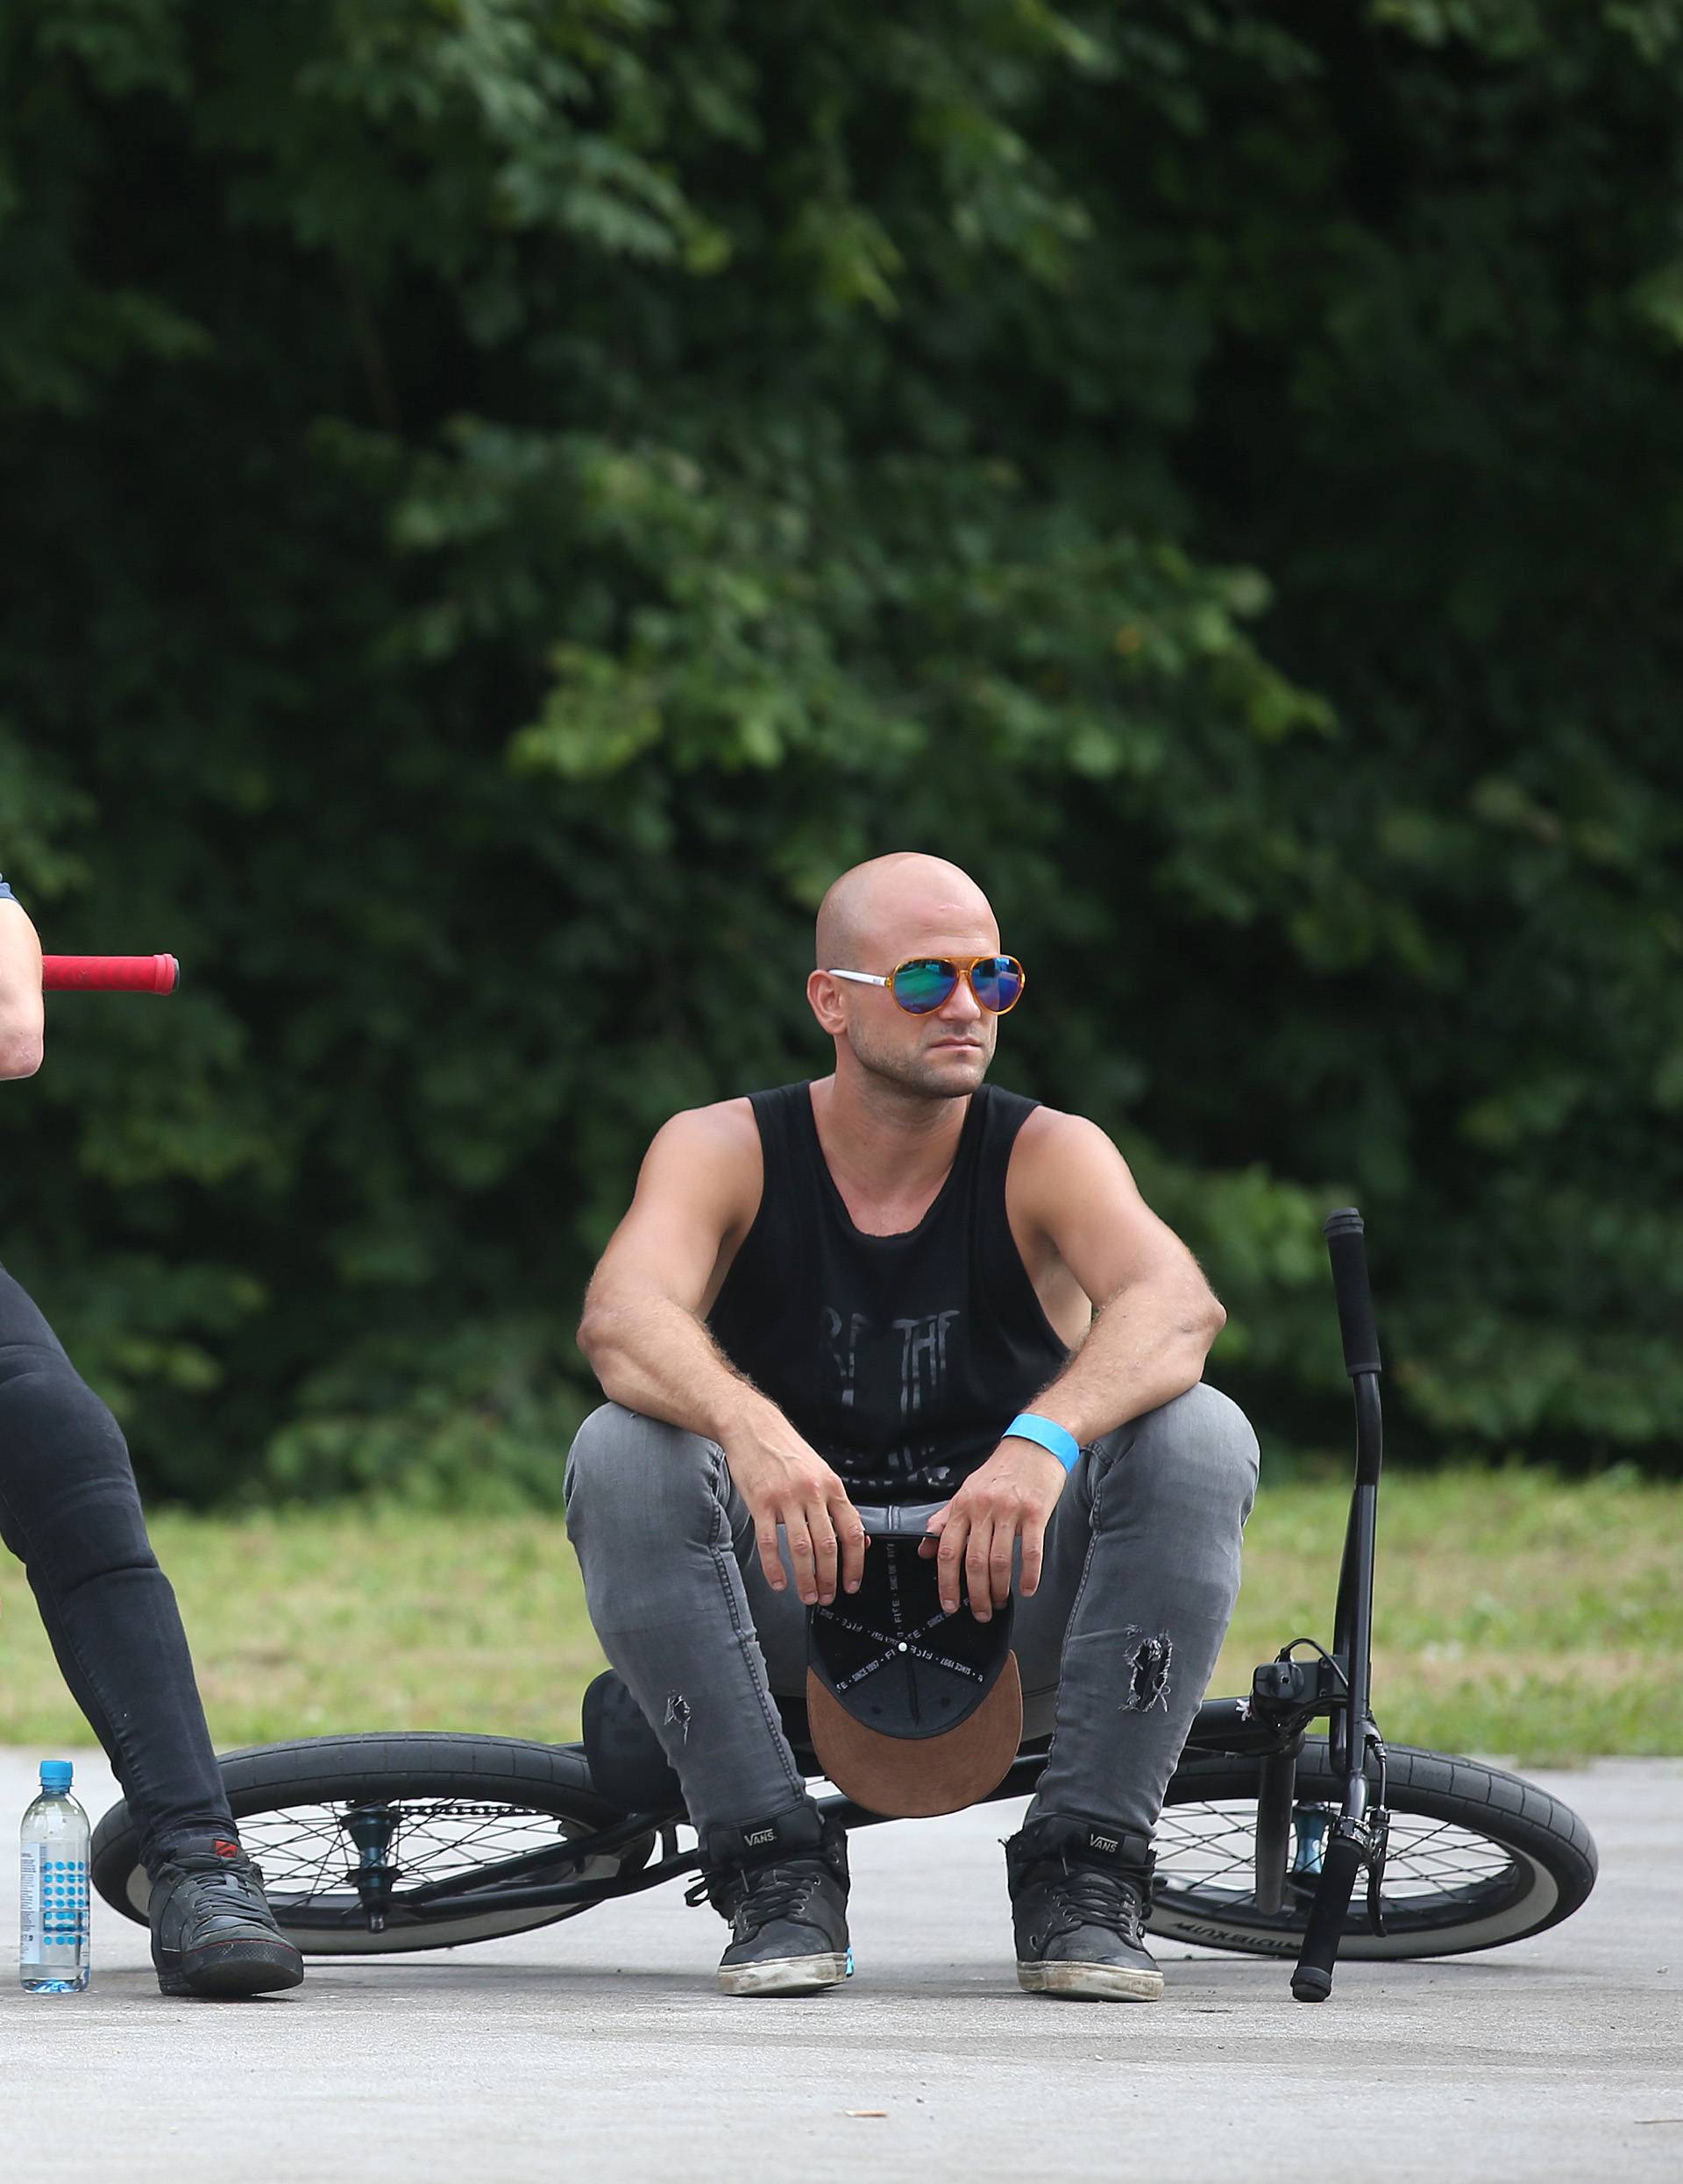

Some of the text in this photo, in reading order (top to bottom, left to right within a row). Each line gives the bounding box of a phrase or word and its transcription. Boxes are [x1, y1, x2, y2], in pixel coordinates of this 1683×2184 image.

[852, 1668, 869, 1682] SINCE
[743, 1828, 775, 1847] VANS
[1090, 1832, 1118, 1853] VANS
